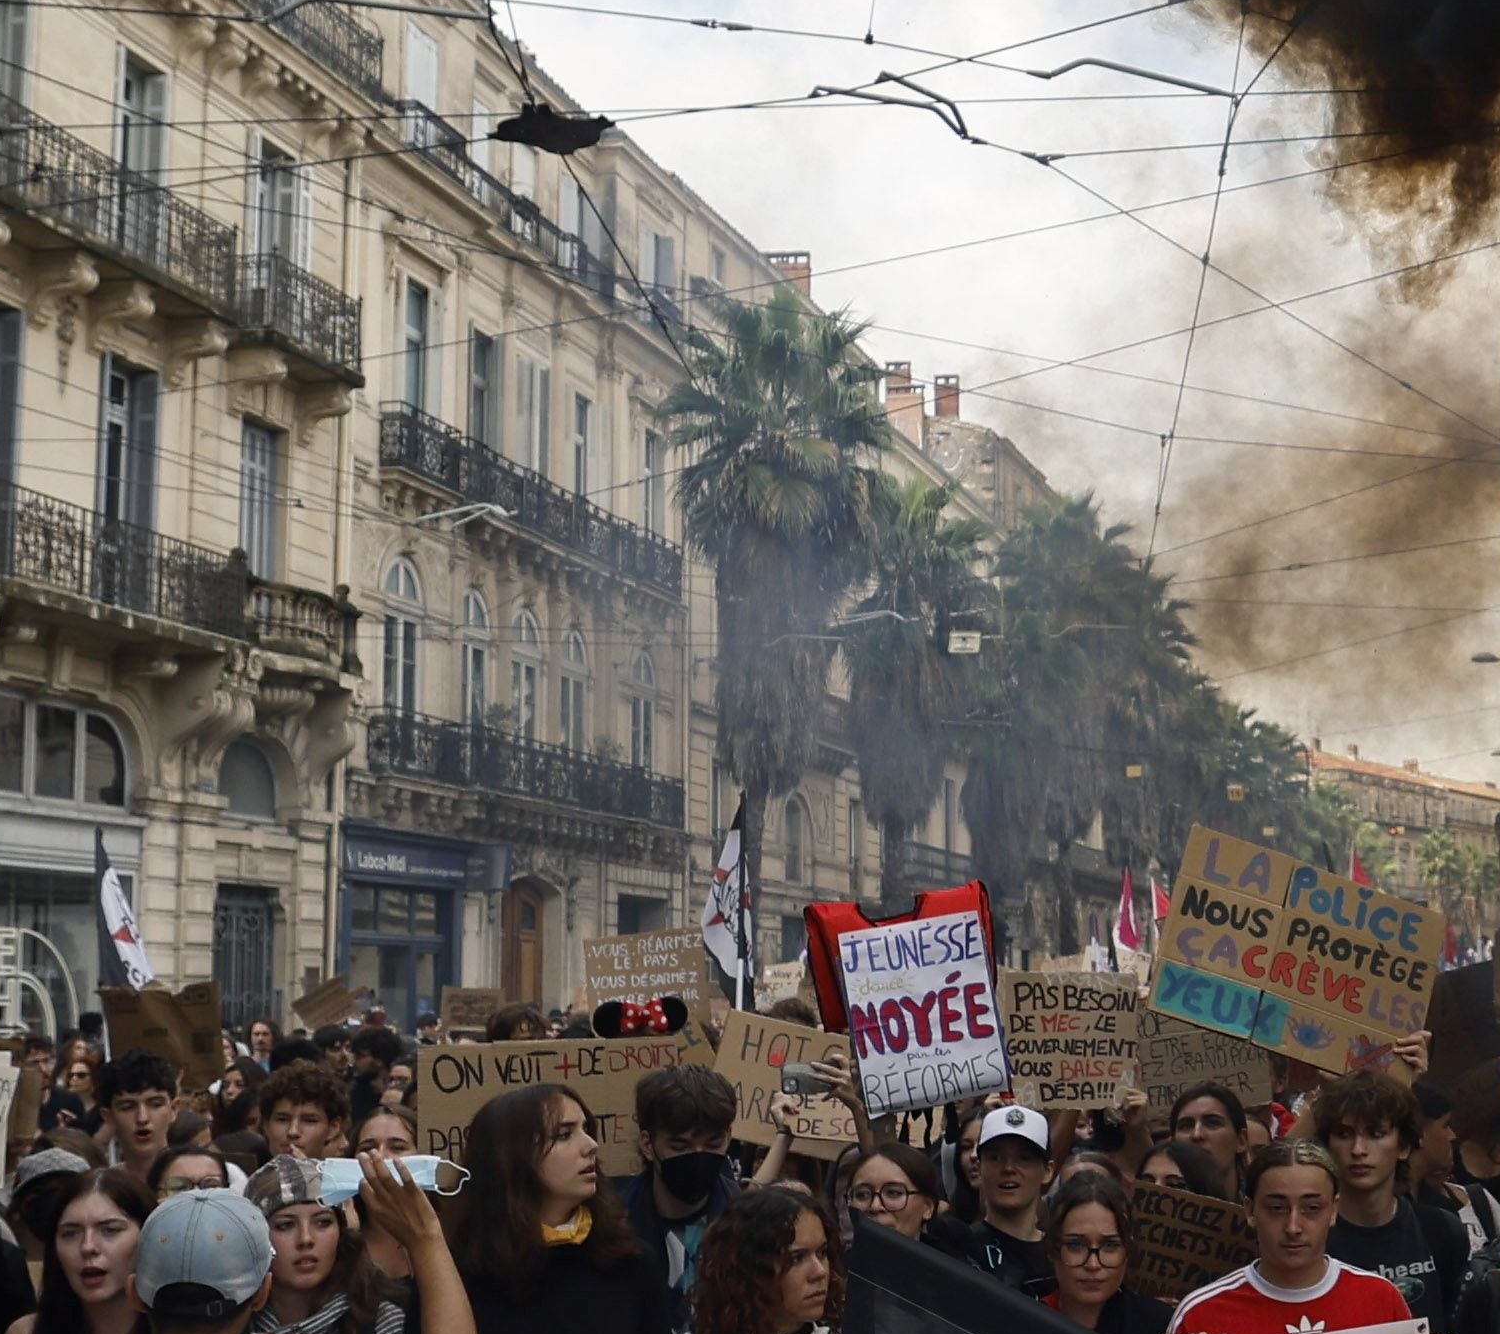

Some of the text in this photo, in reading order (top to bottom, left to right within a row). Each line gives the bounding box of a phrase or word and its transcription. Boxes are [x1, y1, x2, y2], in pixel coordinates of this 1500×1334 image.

[1203, 838, 1423, 953] LA POLICE
[591, 941, 629, 960] VOUS
[840, 919, 983, 974] JEUNESSE
[1180, 885, 1428, 993] NOUS PROTÈGE
[613, 952, 680, 971] LE PAYS
[1176, 927, 1238, 968] ÇA
[1241, 945, 1366, 1014] CRÈVE
[590, 973, 629, 990] VOUS
[1013, 981, 1059, 1014] PAS
[850, 970, 995, 1060] NOYÉE
[1158, 966, 1278, 1038] YEUX
[1010, 1014, 1036, 1034] DE
[1093, 1014, 1116, 1034] LE
[741, 1023, 812, 1068] HOT
[906, 1052, 929, 1066] par
[1006, 1038, 1137, 1058] GOUVERNEMENT
[432, 1052, 484, 1094] ON
[494, 1050, 557, 1085] VEUT
[608, 1043, 676, 1069] DROITS
[863, 1047, 1004, 1113] RÉFORMES
[1010, 1059, 1124, 1082] NOUS BAISE
[1171, 1051, 1228, 1077] GRAND
[796, 1117, 821, 1135] DE
